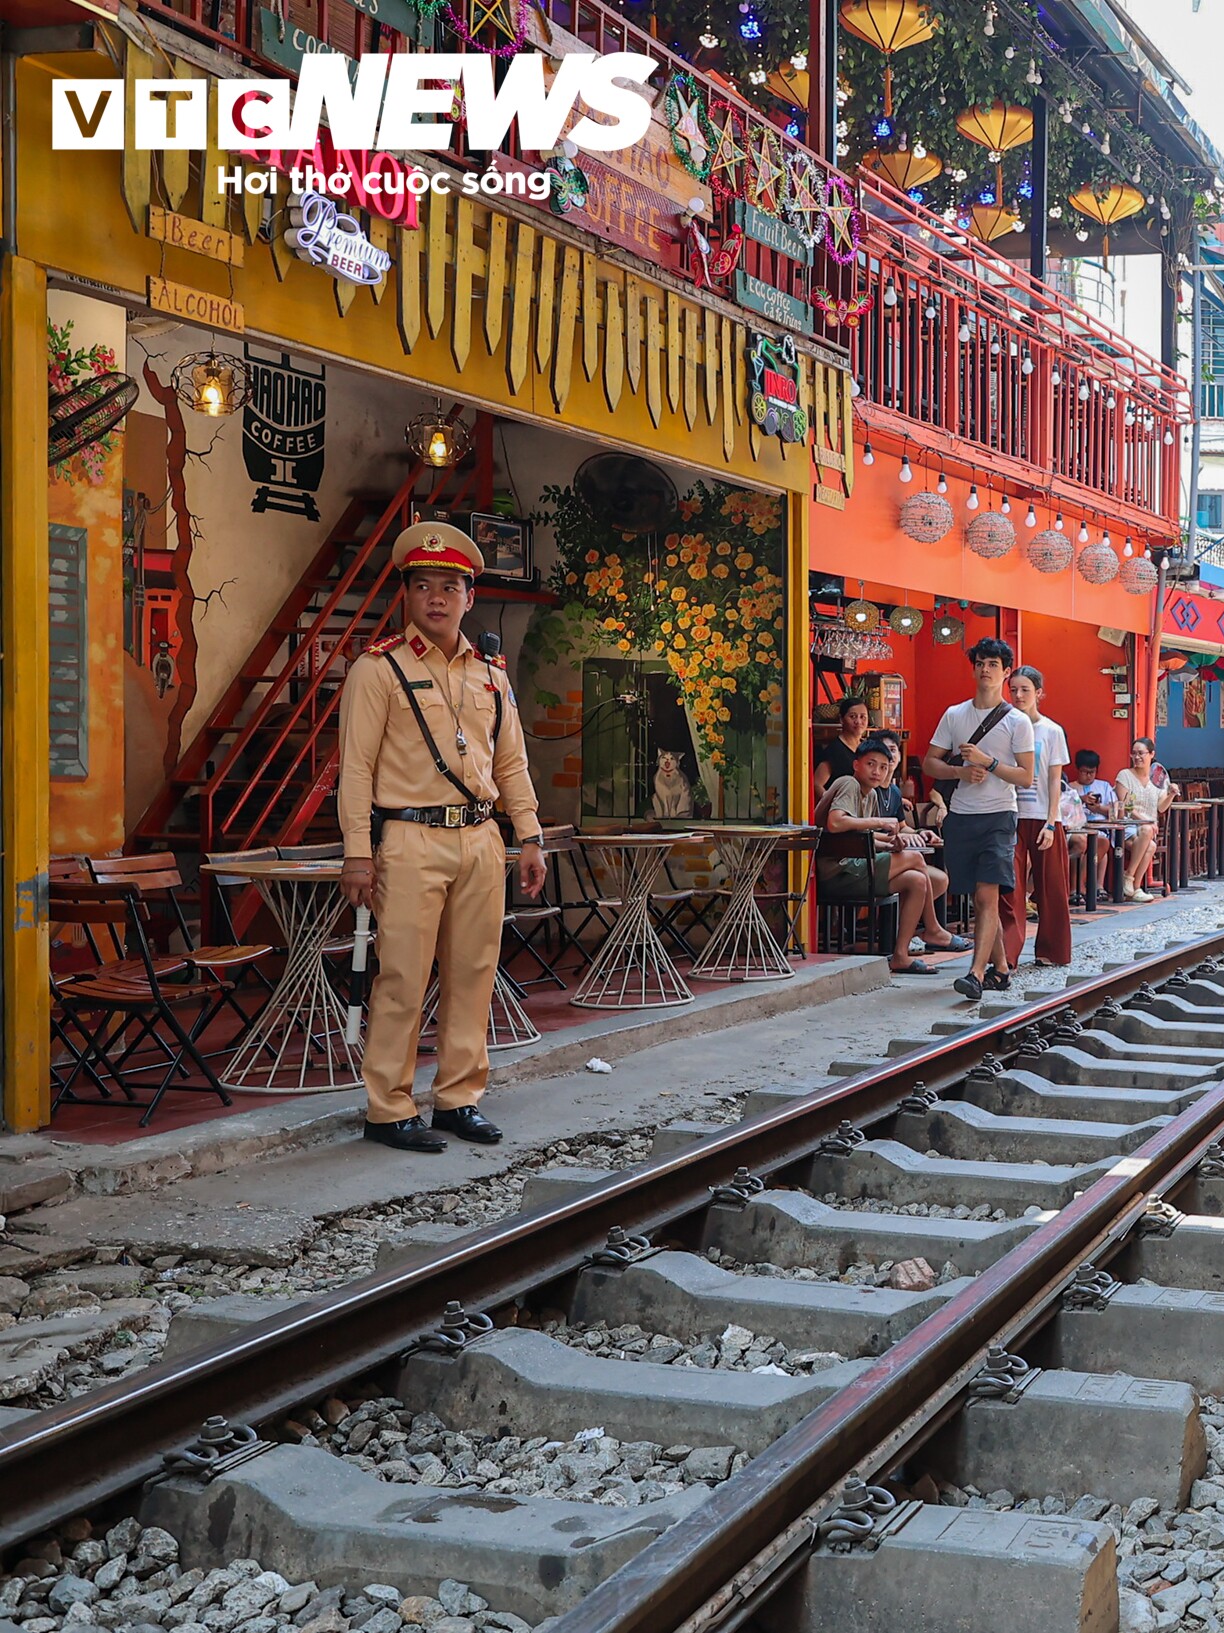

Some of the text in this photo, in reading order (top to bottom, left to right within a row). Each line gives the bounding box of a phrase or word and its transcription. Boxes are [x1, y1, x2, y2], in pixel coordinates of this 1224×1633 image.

[583, 173, 661, 252] OFFEE
[751, 209, 803, 257] Fruit Beer
[171, 215, 225, 254] Beer
[331, 253, 362, 277] BEER
[158, 285, 241, 330] ALCOHOL
[251, 420, 317, 452] COFFEE
